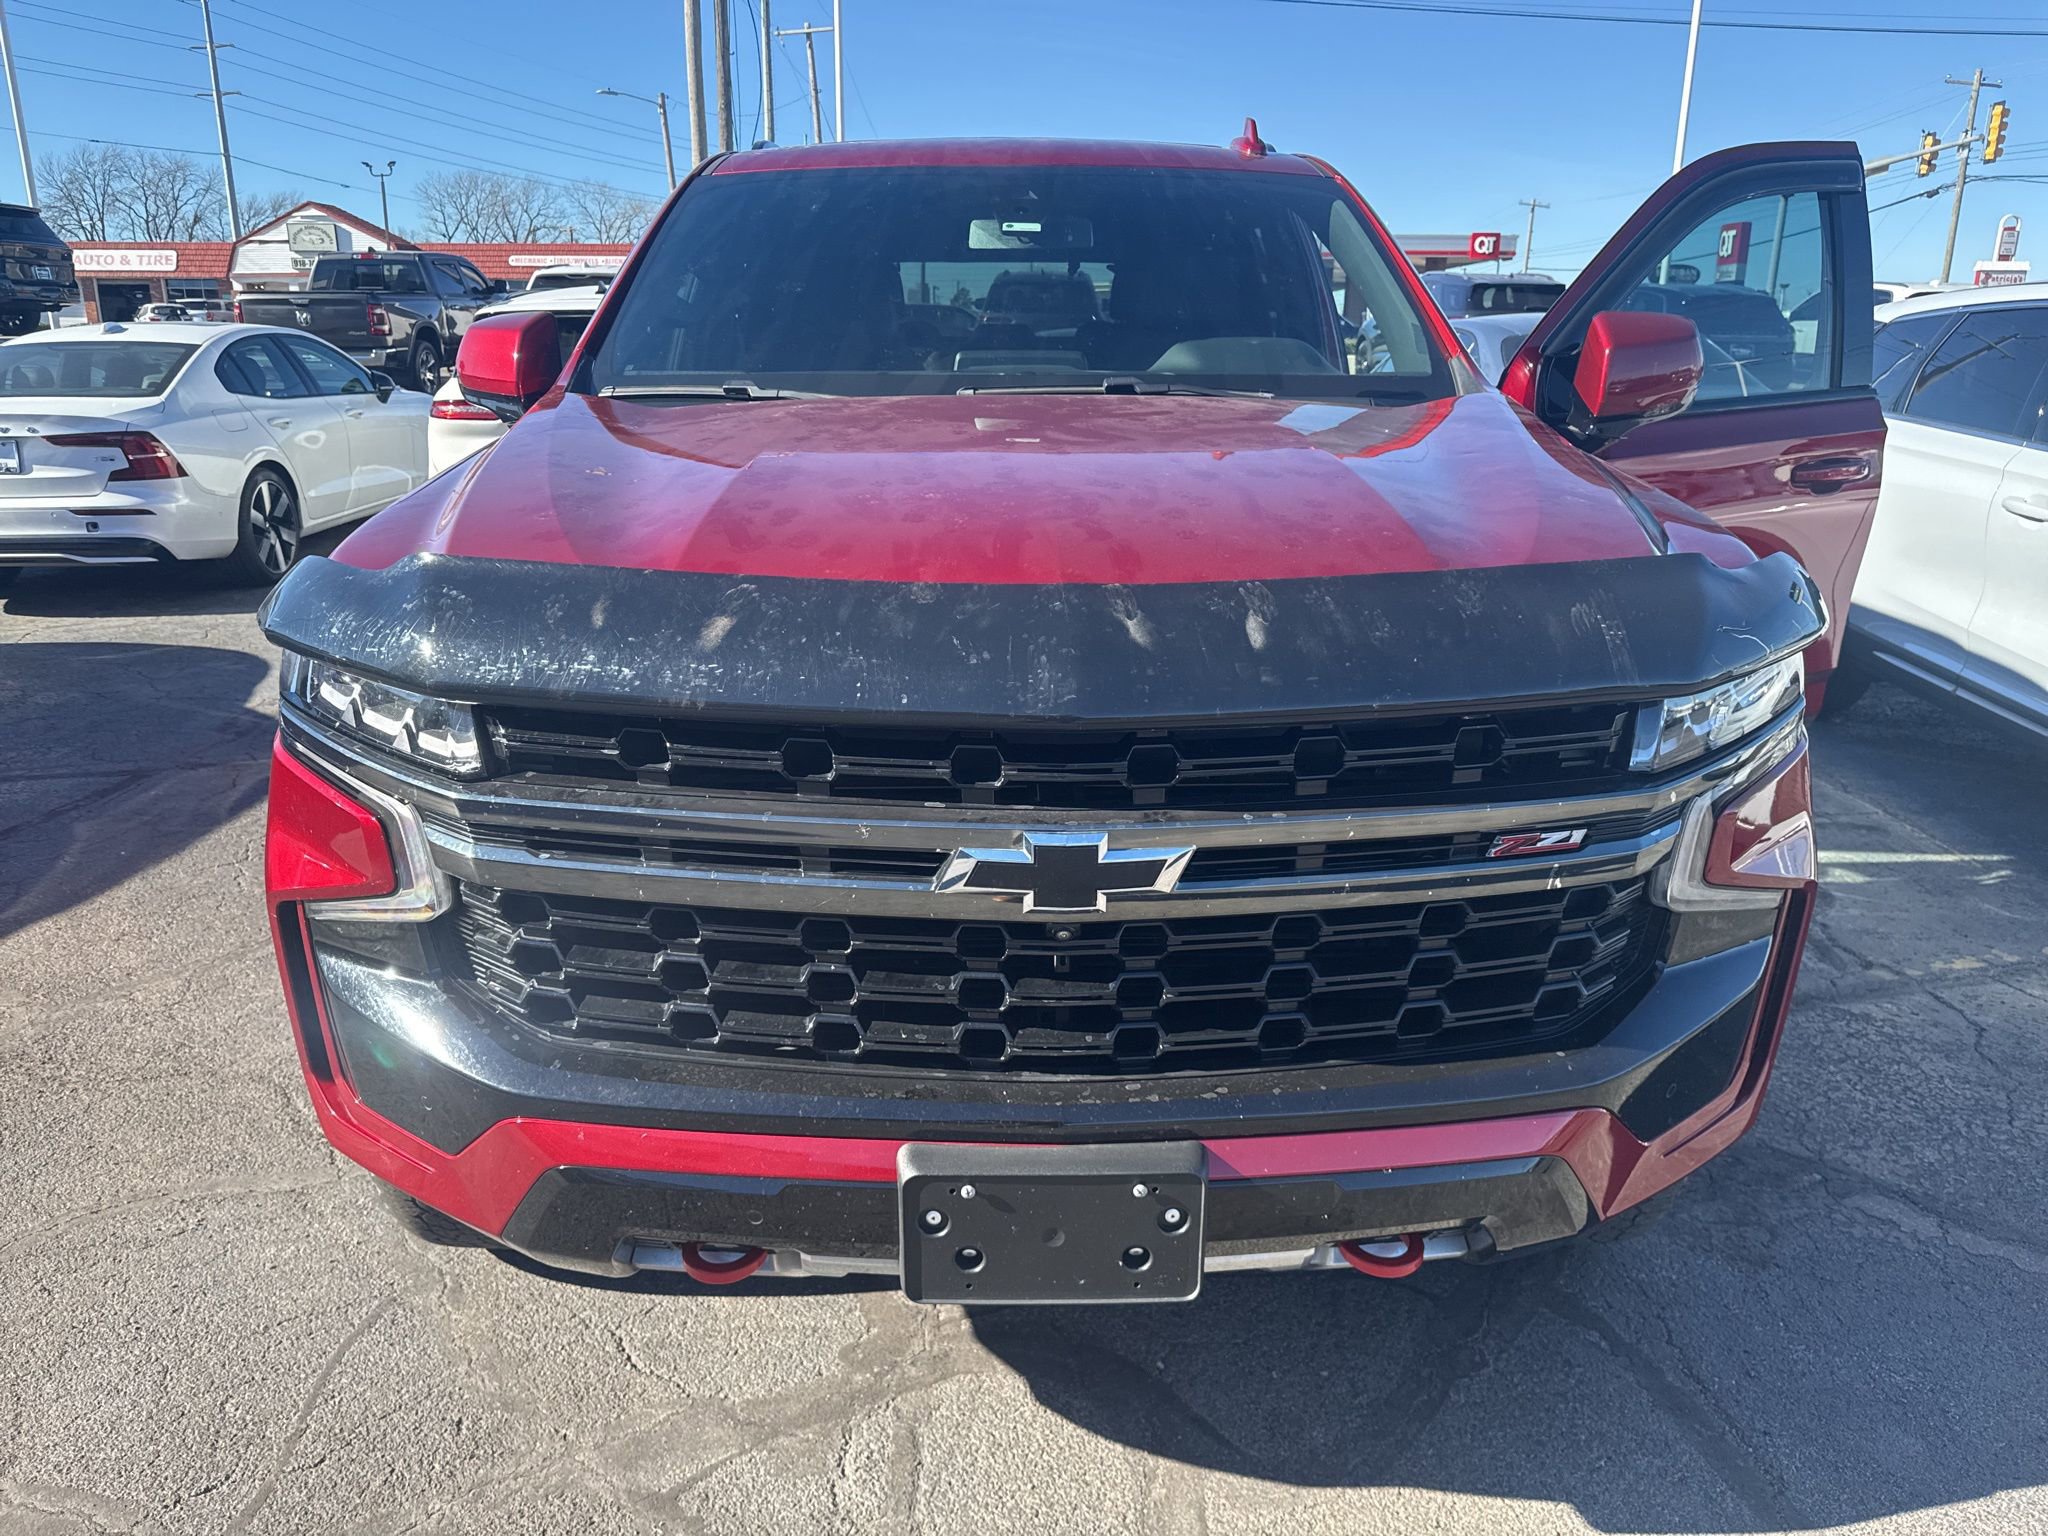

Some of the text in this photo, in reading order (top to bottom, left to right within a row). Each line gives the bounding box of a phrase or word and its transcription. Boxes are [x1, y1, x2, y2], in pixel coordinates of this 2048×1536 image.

[1473, 235, 1497, 255] QT
[1719, 229, 1737, 258] QT
[74, 254, 174, 266] AUTO & TIRE
